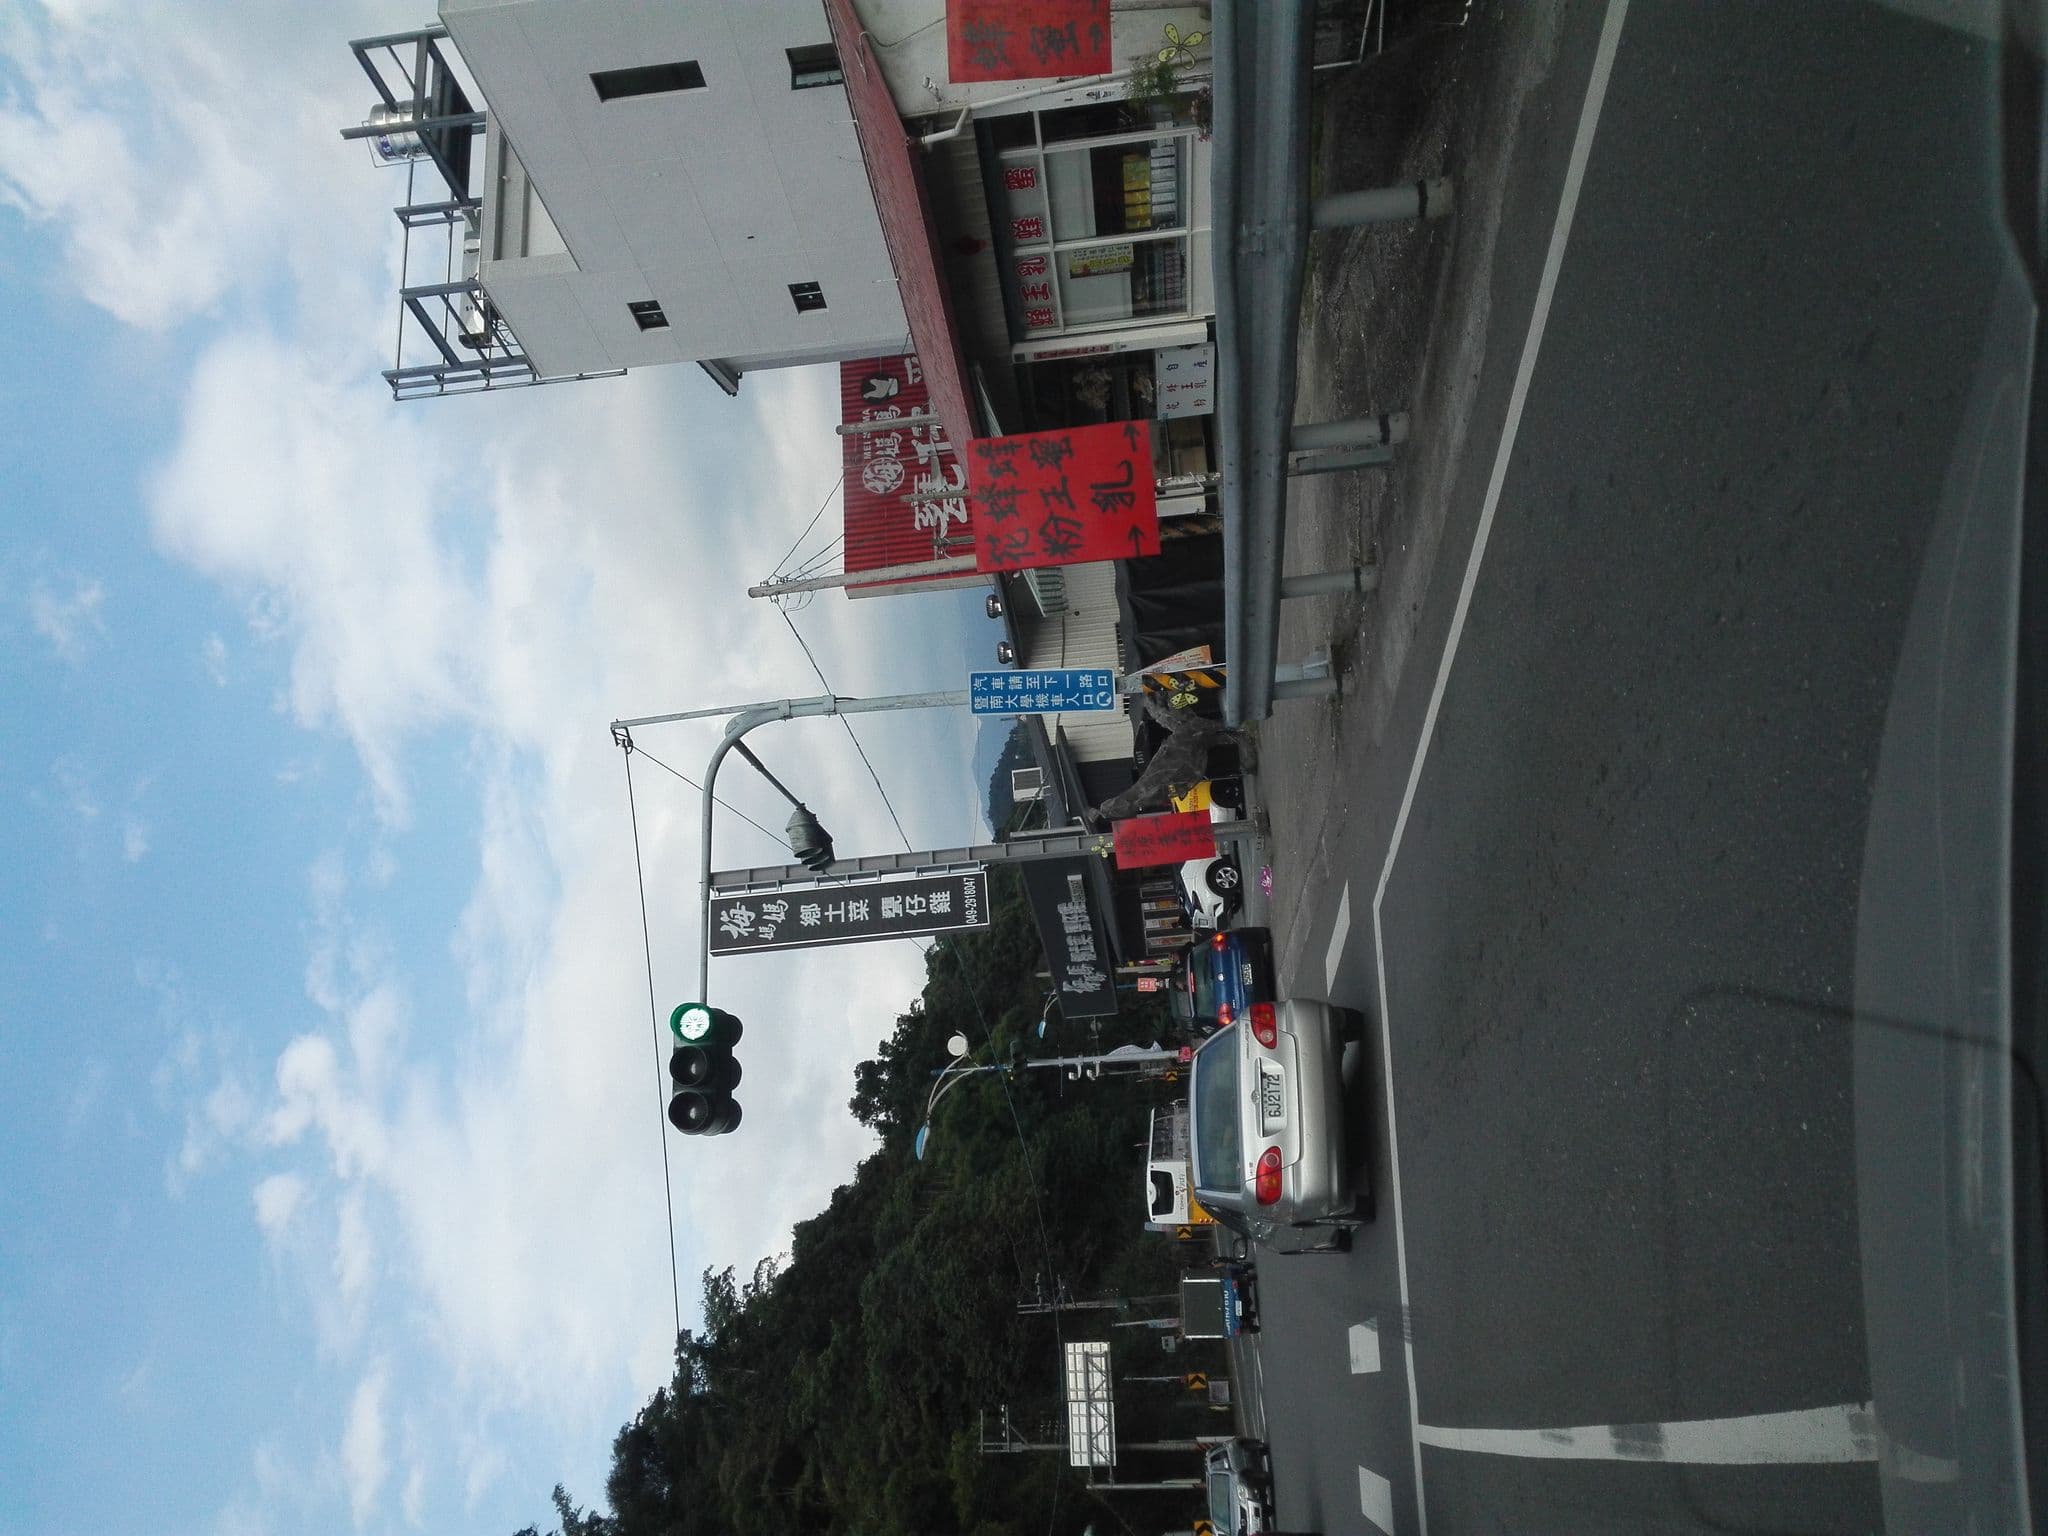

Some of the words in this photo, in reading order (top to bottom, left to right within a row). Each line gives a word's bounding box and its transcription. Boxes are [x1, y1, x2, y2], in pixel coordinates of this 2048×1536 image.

[1015, 256, 1054, 327] 蜂王乳
[863, 441, 871, 460] MEI
[973, 459, 1136, 523] 蜂王乳
[985, 511, 1084, 564] 花粉
[973, 673, 1109, 692] 汽車請至下一路口
[974, 692, 1094, 710] 暨南大學機車入口
[719, 899, 789, 940] 梅媽媽
[799, 898, 870, 927] 鄉土菜
[881, 890, 951, 919] 甕仔雞
[963, 876, 978, 924] 049-2918047
[1266, 1074, 1282, 1117] 6J-2172
